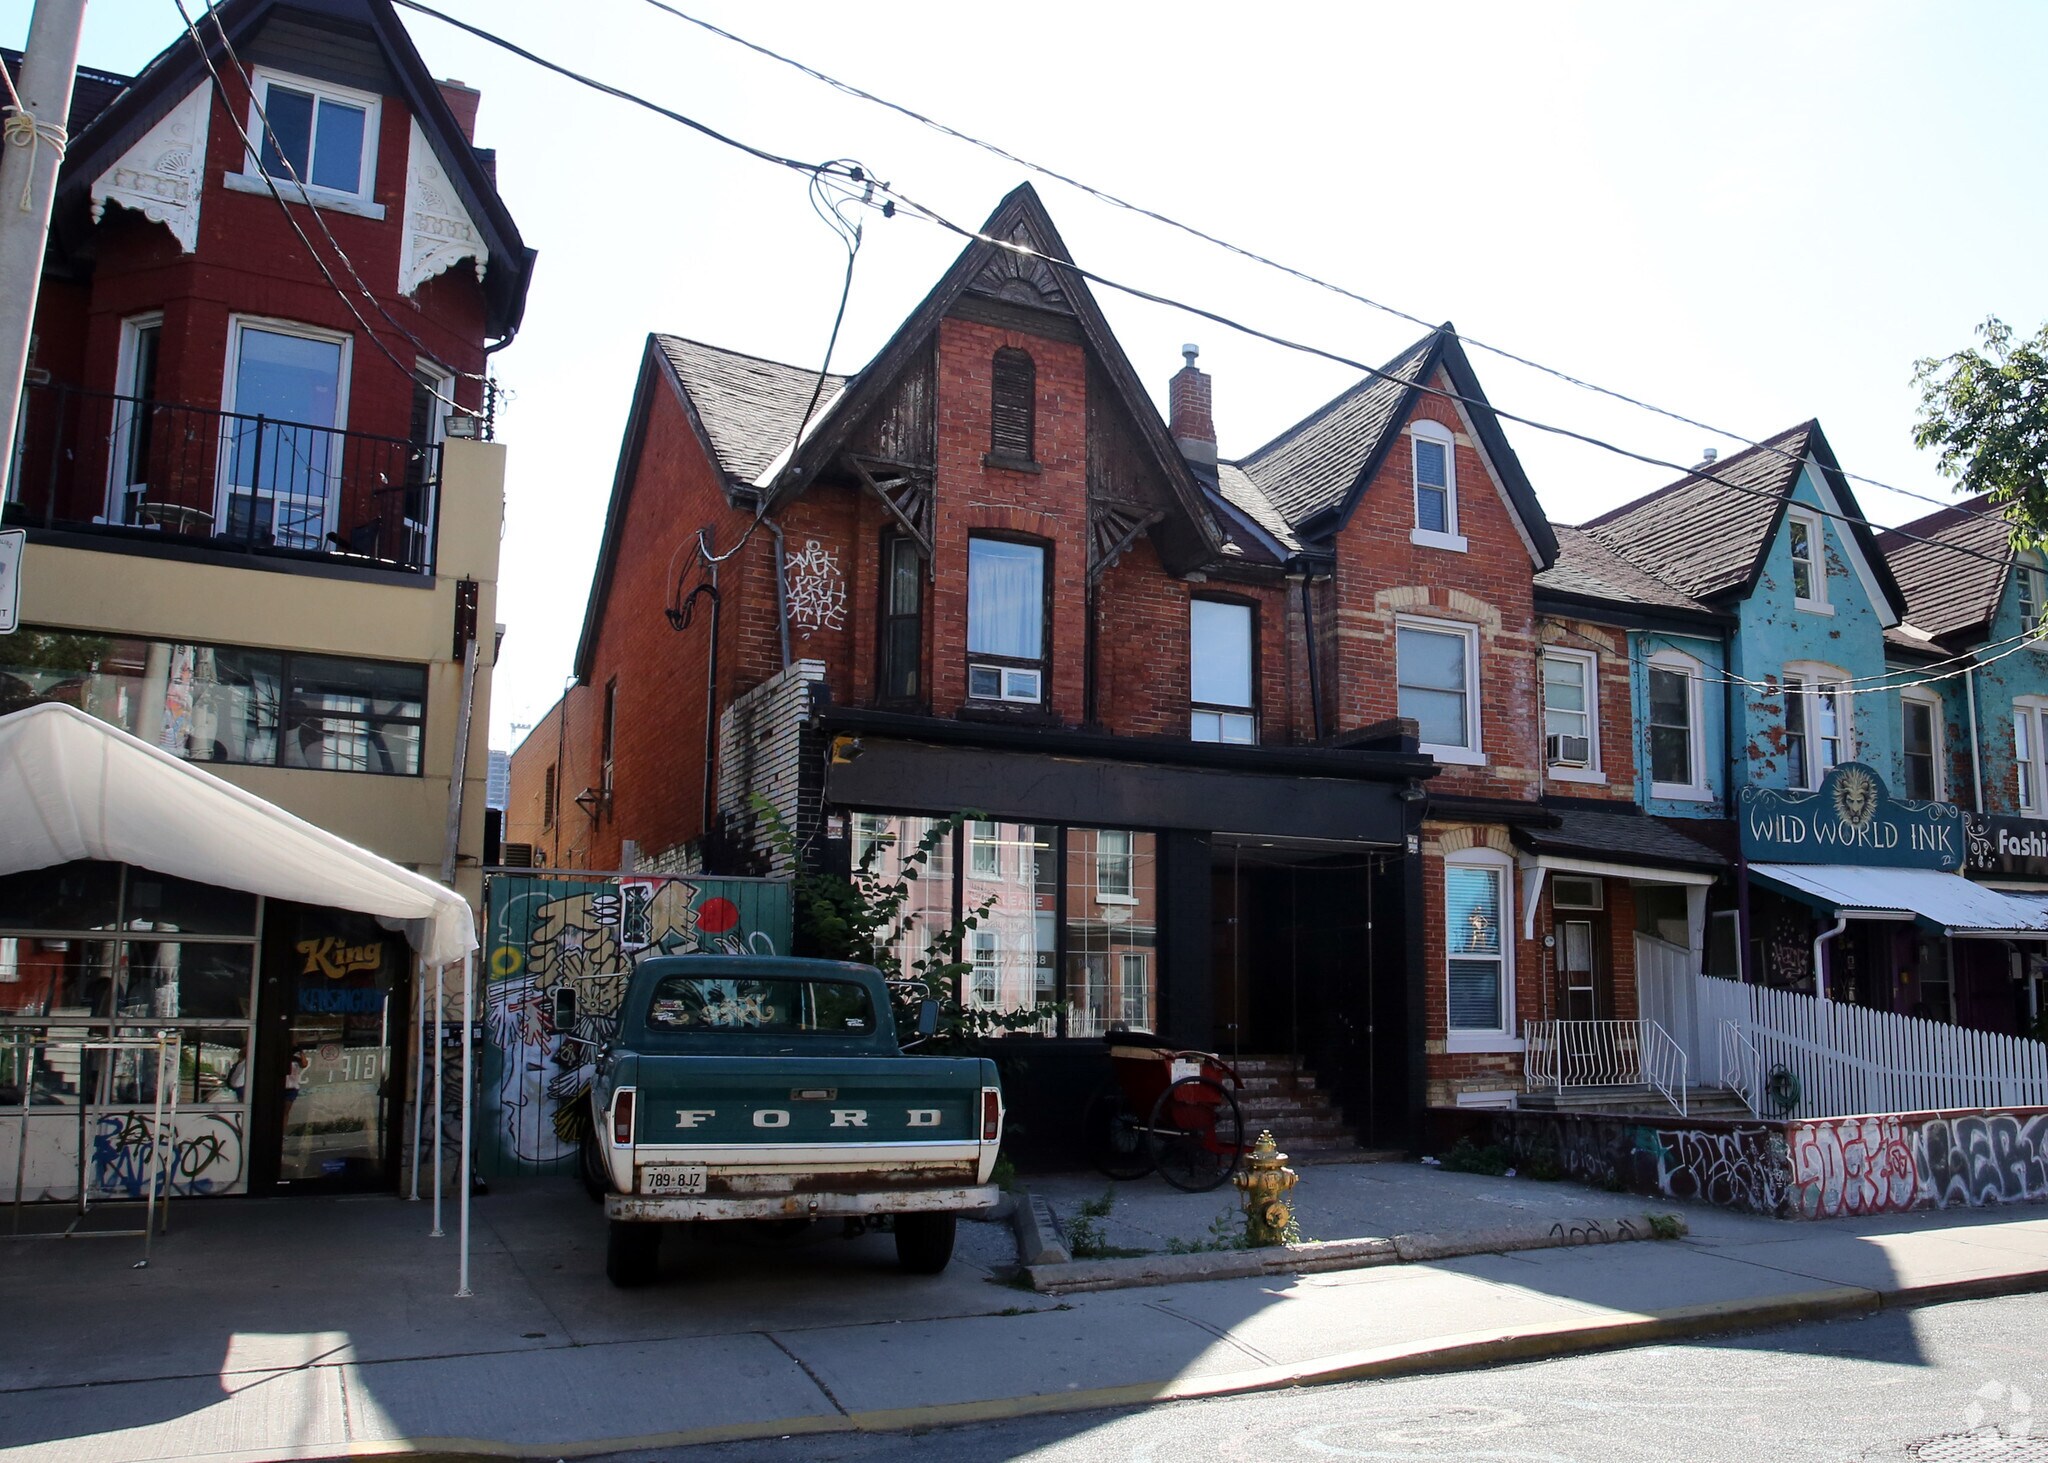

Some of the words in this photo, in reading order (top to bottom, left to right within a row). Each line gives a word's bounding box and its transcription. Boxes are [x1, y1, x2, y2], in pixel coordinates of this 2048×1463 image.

[1750, 804, 1806, 844] WILD
[1813, 808, 1899, 850] WORLD
[1911, 822, 1955, 855] INK
[1998, 828, 2048, 857] Fashi
[296, 936, 382, 980] King
[675, 1108, 942, 1128] FORD
[648, 1173, 671, 1187] 789
[677, 1173, 701, 1187] 8JZ
